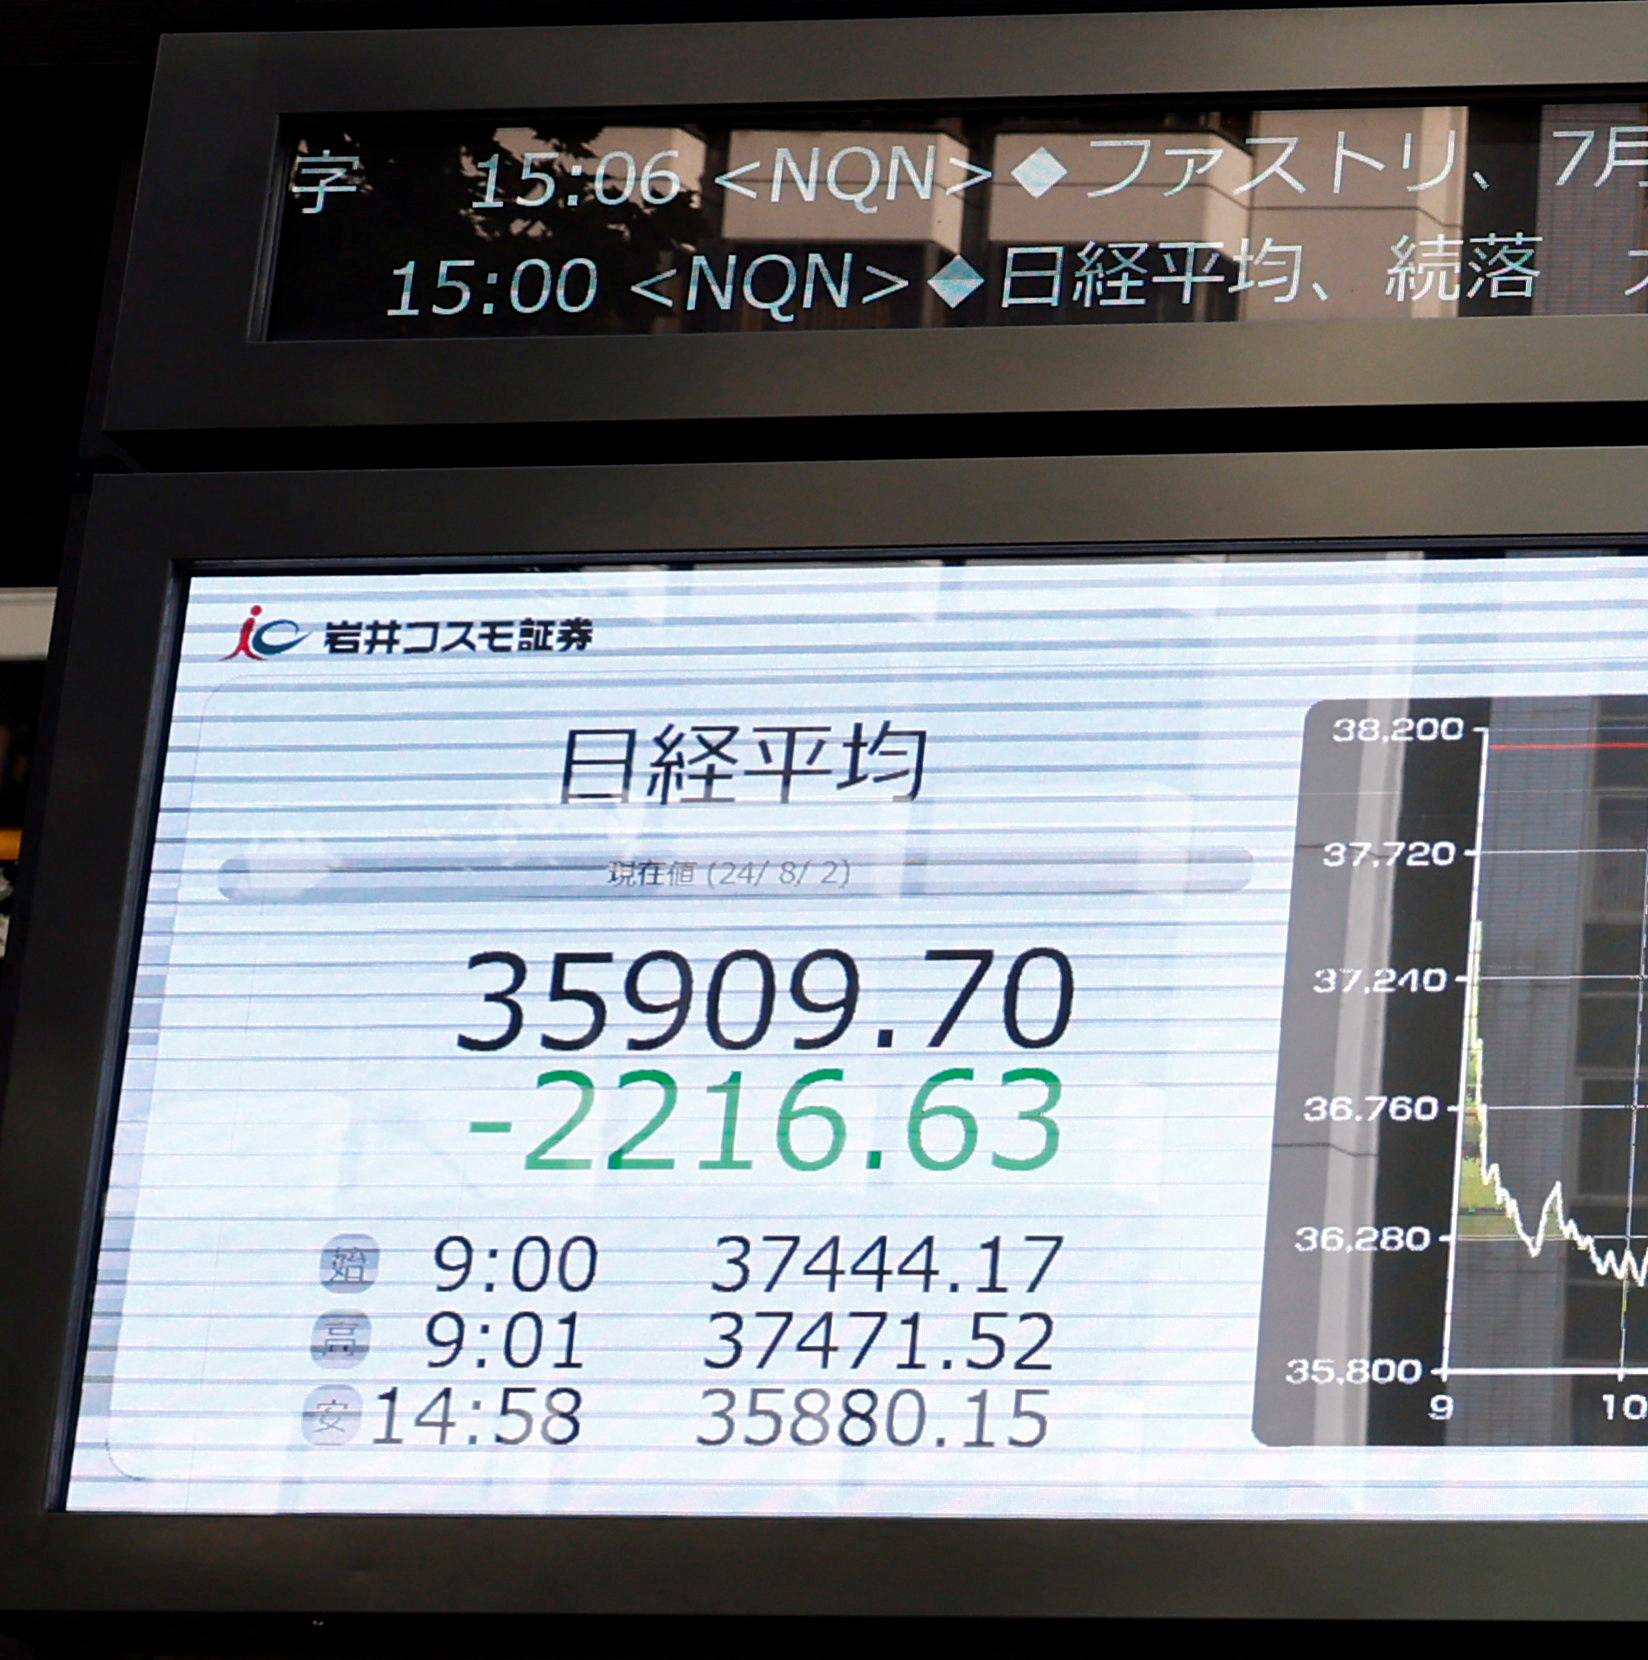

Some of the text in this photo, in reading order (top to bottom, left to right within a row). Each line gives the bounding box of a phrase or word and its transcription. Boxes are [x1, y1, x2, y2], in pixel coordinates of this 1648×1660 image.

[292, 149, 360, 214] 字
[472, 150, 681, 207] 15:06
[714, 144, 992, 213] <NQN>
[387, 257, 598, 316] 15:00
[630, 252, 909, 322] <NQN>
[324, 616, 593, 655] 岩井コスモ証券
[558, 720, 927, 805] 日経平均
[455, 946, 1076, 1051] 35909.70
[467, 1068, 1063, 1172] -2216.63
[433, 1235, 598, 1292] 9:00
[710, 1235, 1064, 1293] 37444.17
[426, 1311, 583, 1368] 9:01
[702, 1311, 1056, 1370] 37471.52
[372, 1387, 583, 1446] 14:58
[695, 1387, 1050, 1447] 35880.15
[1427, 1394, 1455, 1420] 9
[1602, 1396, 1648, 1420] 10
